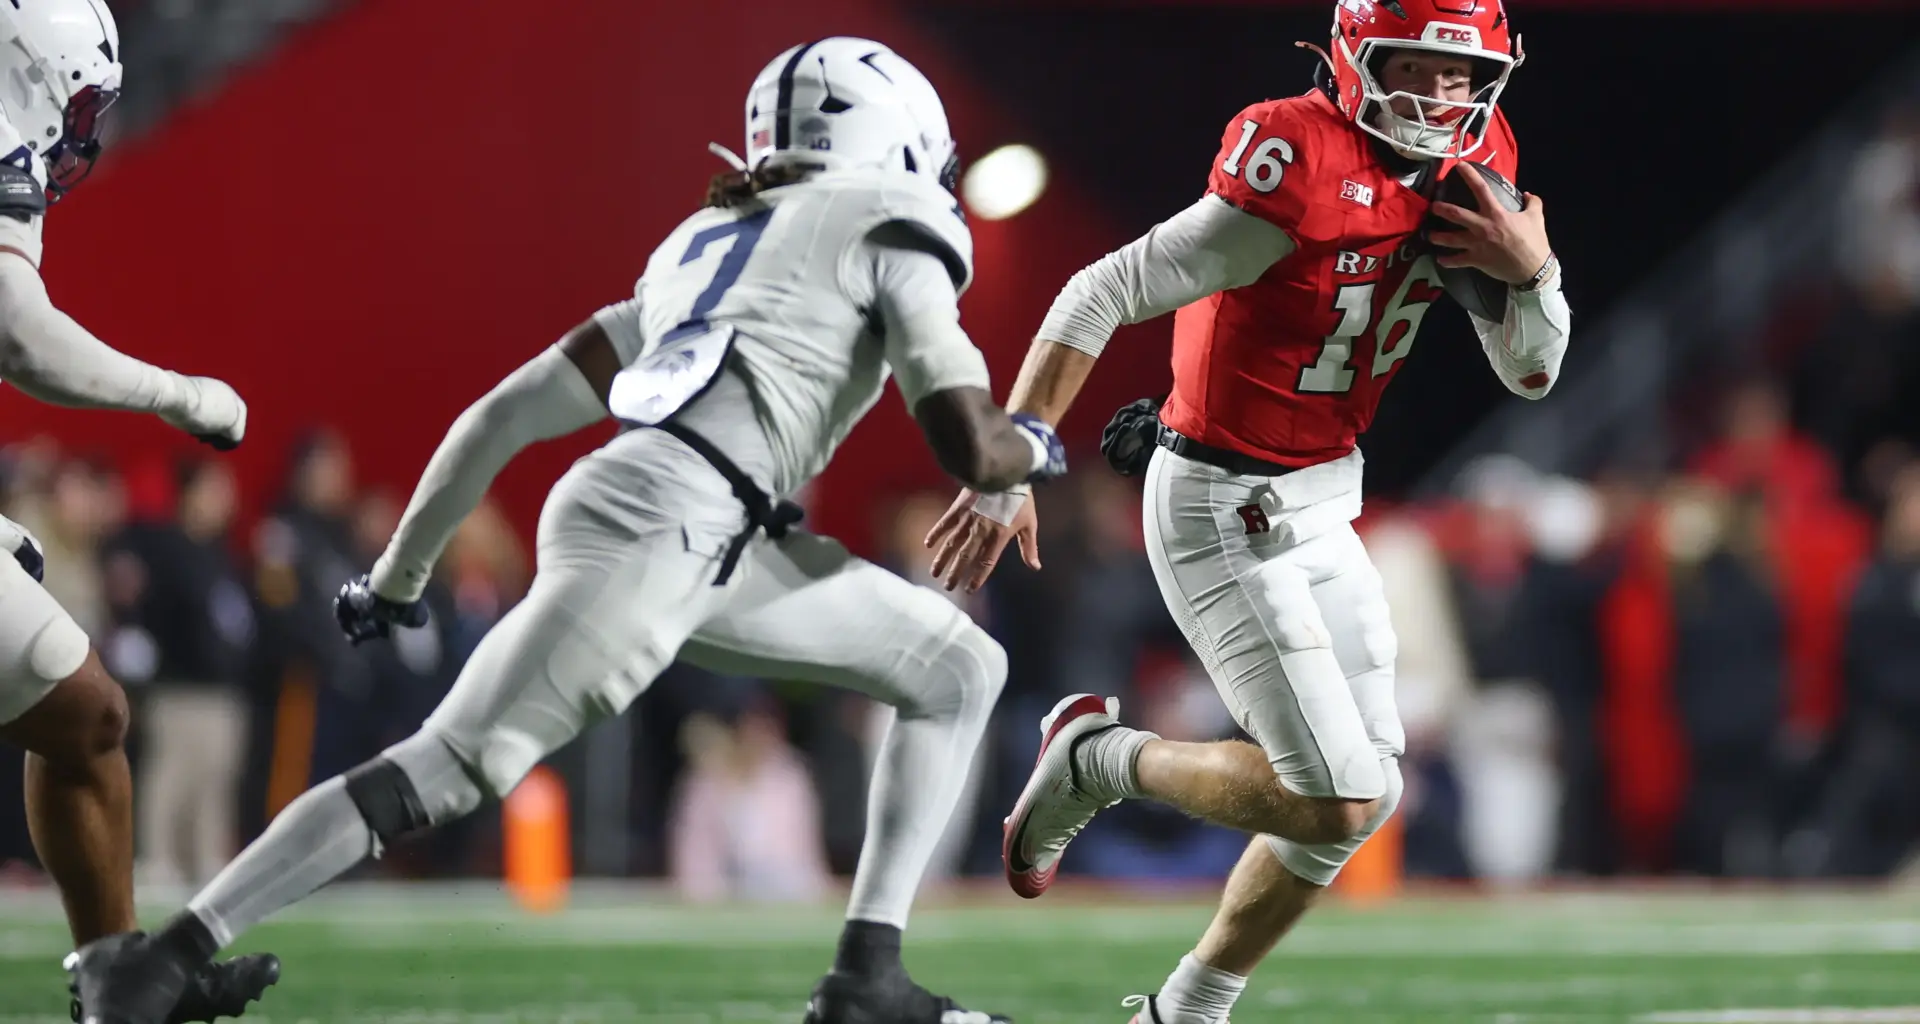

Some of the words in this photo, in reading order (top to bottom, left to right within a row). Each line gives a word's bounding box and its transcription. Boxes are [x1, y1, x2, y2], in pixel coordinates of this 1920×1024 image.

[1221, 119, 1294, 194] 16
[660, 207, 777, 347] 7
[1297, 253, 1445, 392] 16
